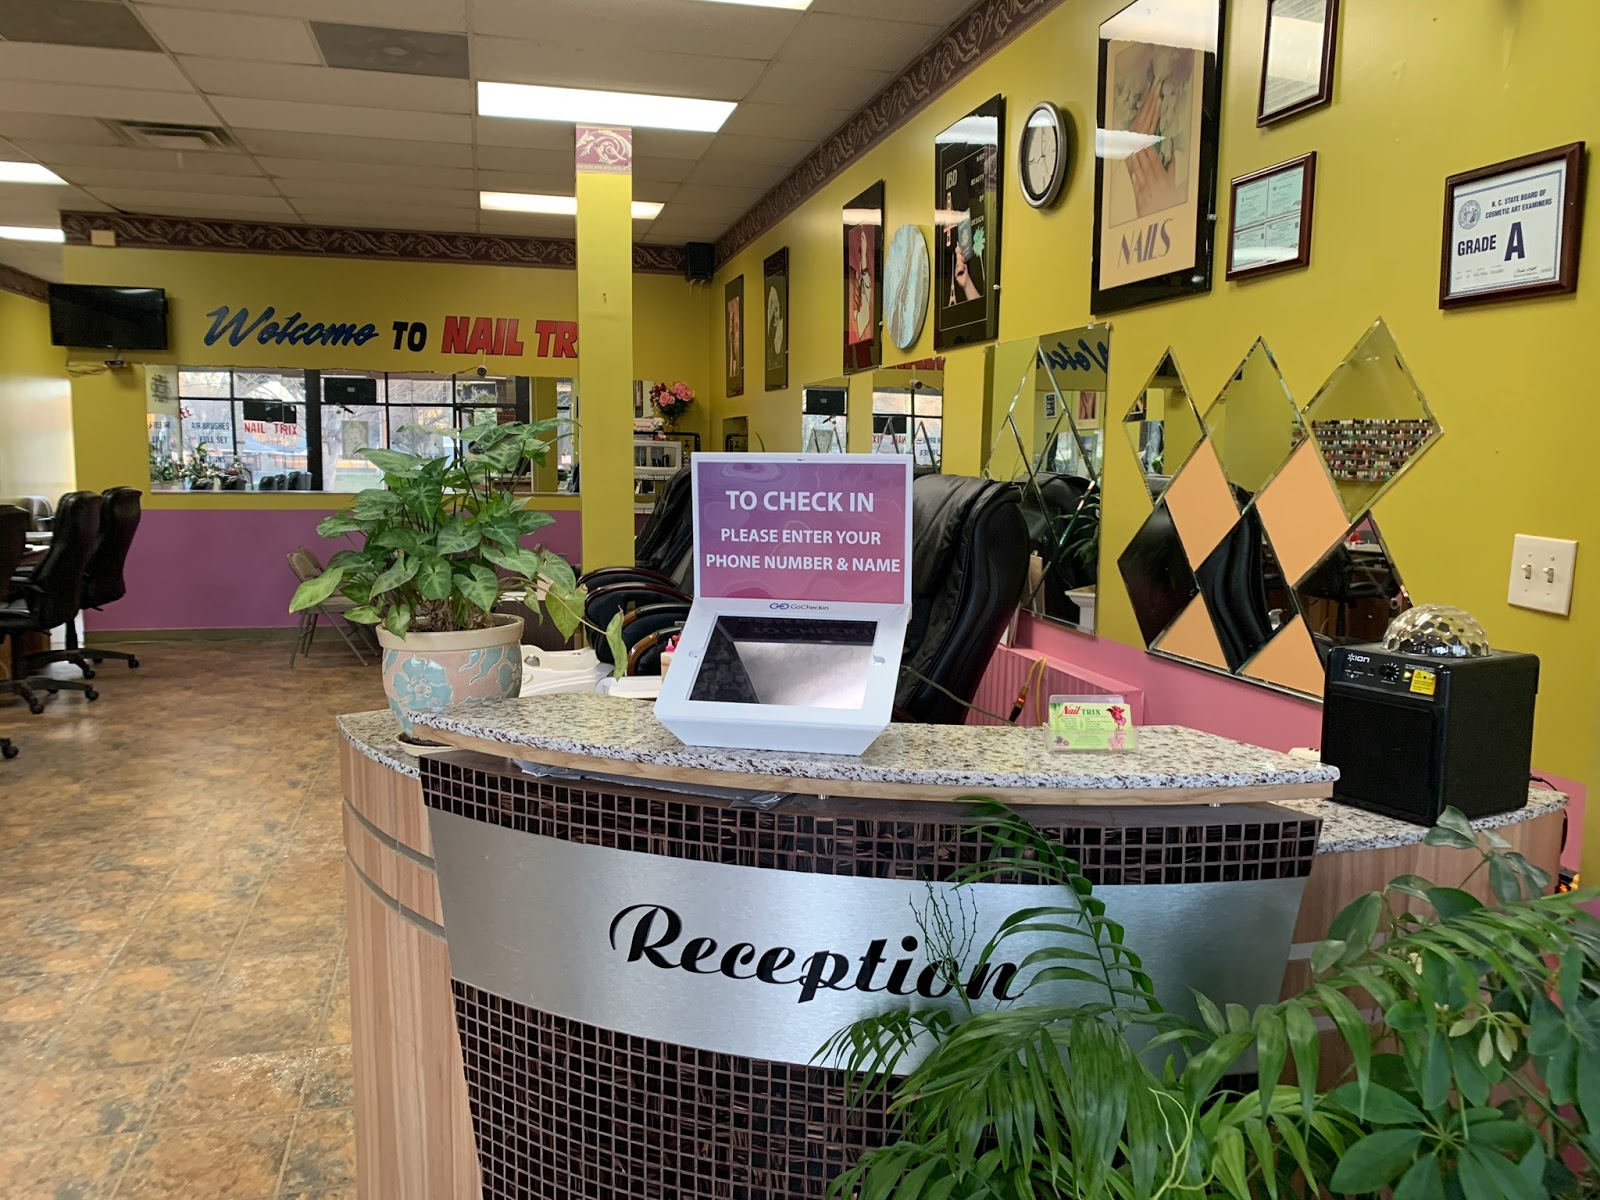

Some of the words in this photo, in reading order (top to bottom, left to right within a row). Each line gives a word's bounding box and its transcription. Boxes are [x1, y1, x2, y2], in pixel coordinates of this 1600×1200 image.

[946, 169, 957, 190] IBD
[1504, 195, 1519, 205] STATE
[1520, 191, 1538, 201] BOARD
[1539, 189, 1546, 197] OF
[1486, 207, 1510, 219] COSMETIC
[1510, 205, 1521, 214] ART
[1522, 198, 1552, 211] EXAMINERS
[1117, 218, 1174, 268] NAILS
[1457, 234, 1497, 257] GRADE
[1504, 221, 1526, 262] A
[204, 306, 379, 347] Welcome
[393, 321, 428, 352] TO
[441, 315, 524, 356] NAIL
[244, 423, 266, 434] NAIL
[274, 423, 298, 436] TRIX
[216, 436, 228, 444] SET
[725, 490, 758, 511] TO
[763, 491, 843, 512] CHECK
[850, 492, 874, 513] IN
[721, 528, 778, 543] PLEASE
[782, 530, 833, 544] ENTER
[836, 531, 881, 545] YOUR
[706, 554, 760, 569] PHONE
[764, 555, 833, 571] NUMBER
[837, 557, 849, 571] &
[852, 558, 900, 573] NAME
[790, 603, 830, 611] GoCheckin
[1058, 704, 1082, 718] Nail
[1081, 708, 1101, 716] TRIX
[609, 904, 1024, 1003] Reception
